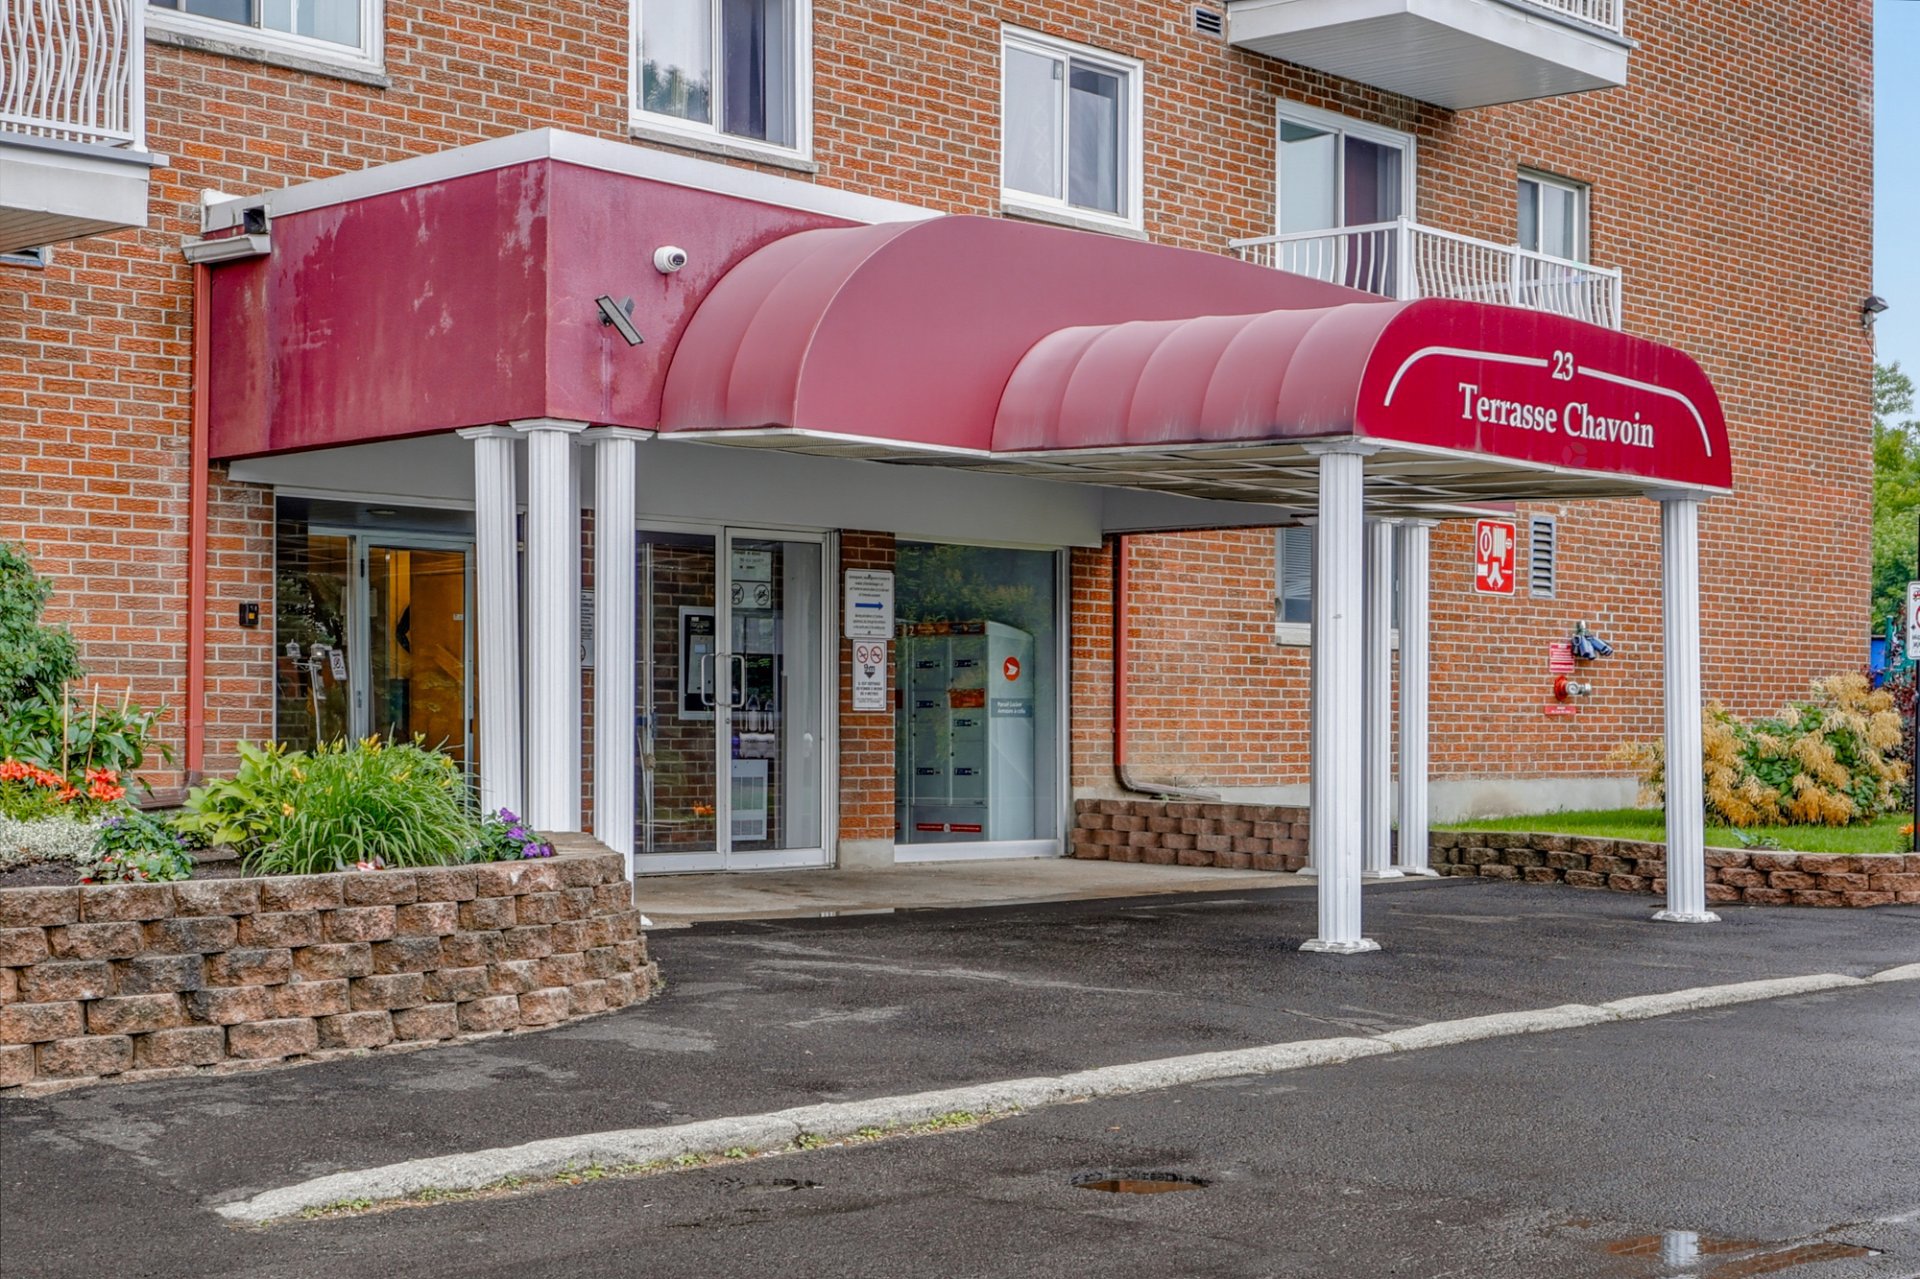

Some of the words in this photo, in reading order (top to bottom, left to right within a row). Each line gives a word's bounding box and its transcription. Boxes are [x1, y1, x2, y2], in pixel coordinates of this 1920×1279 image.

[1552, 350, 1574, 381] 23
[1458, 382, 1558, 434] Terrasse
[1563, 402, 1655, 448] Chavoin
